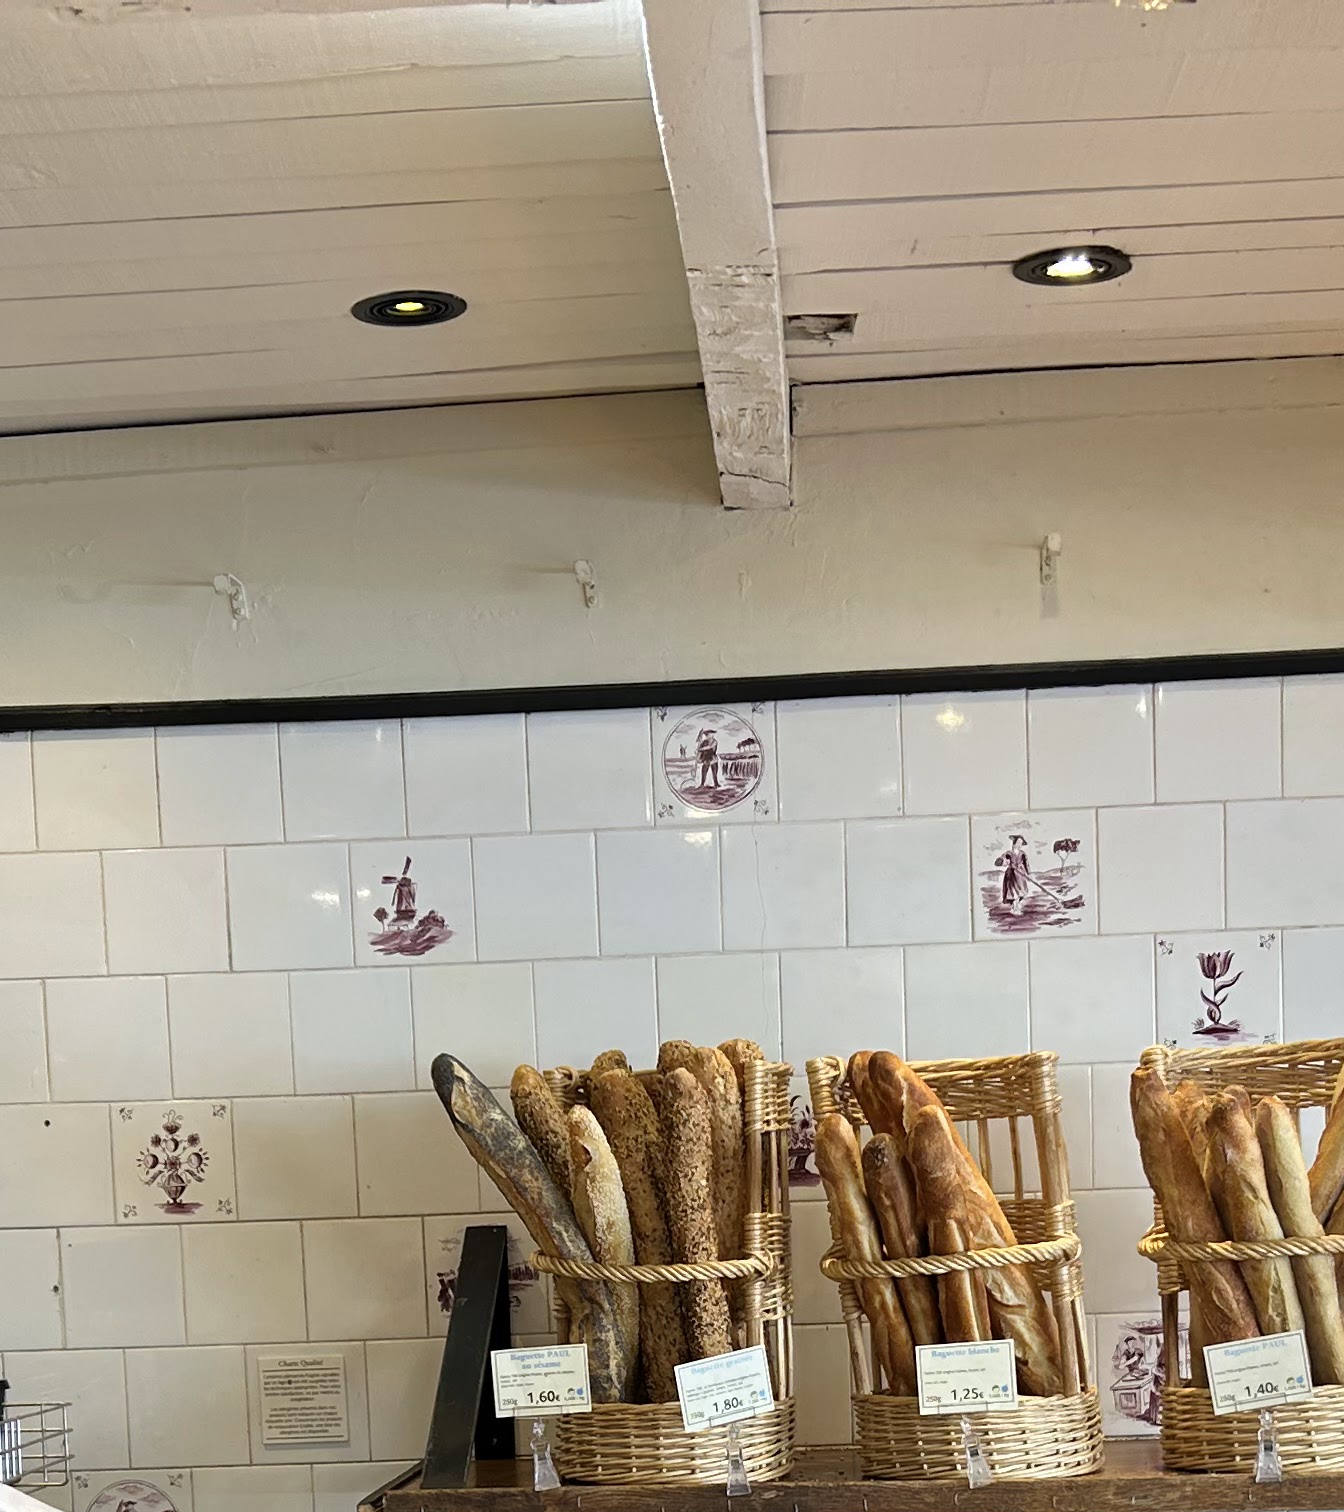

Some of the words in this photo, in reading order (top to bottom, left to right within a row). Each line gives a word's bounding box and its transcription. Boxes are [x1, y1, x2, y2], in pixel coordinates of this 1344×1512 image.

[527, 1390, 561, 1405] 1,60€
[950, 1387, 984, 1402] 1,25€
[1244, 1382, 1280, 1399] 1,40€
[712, 1396, 744, 1415] 1,80€
